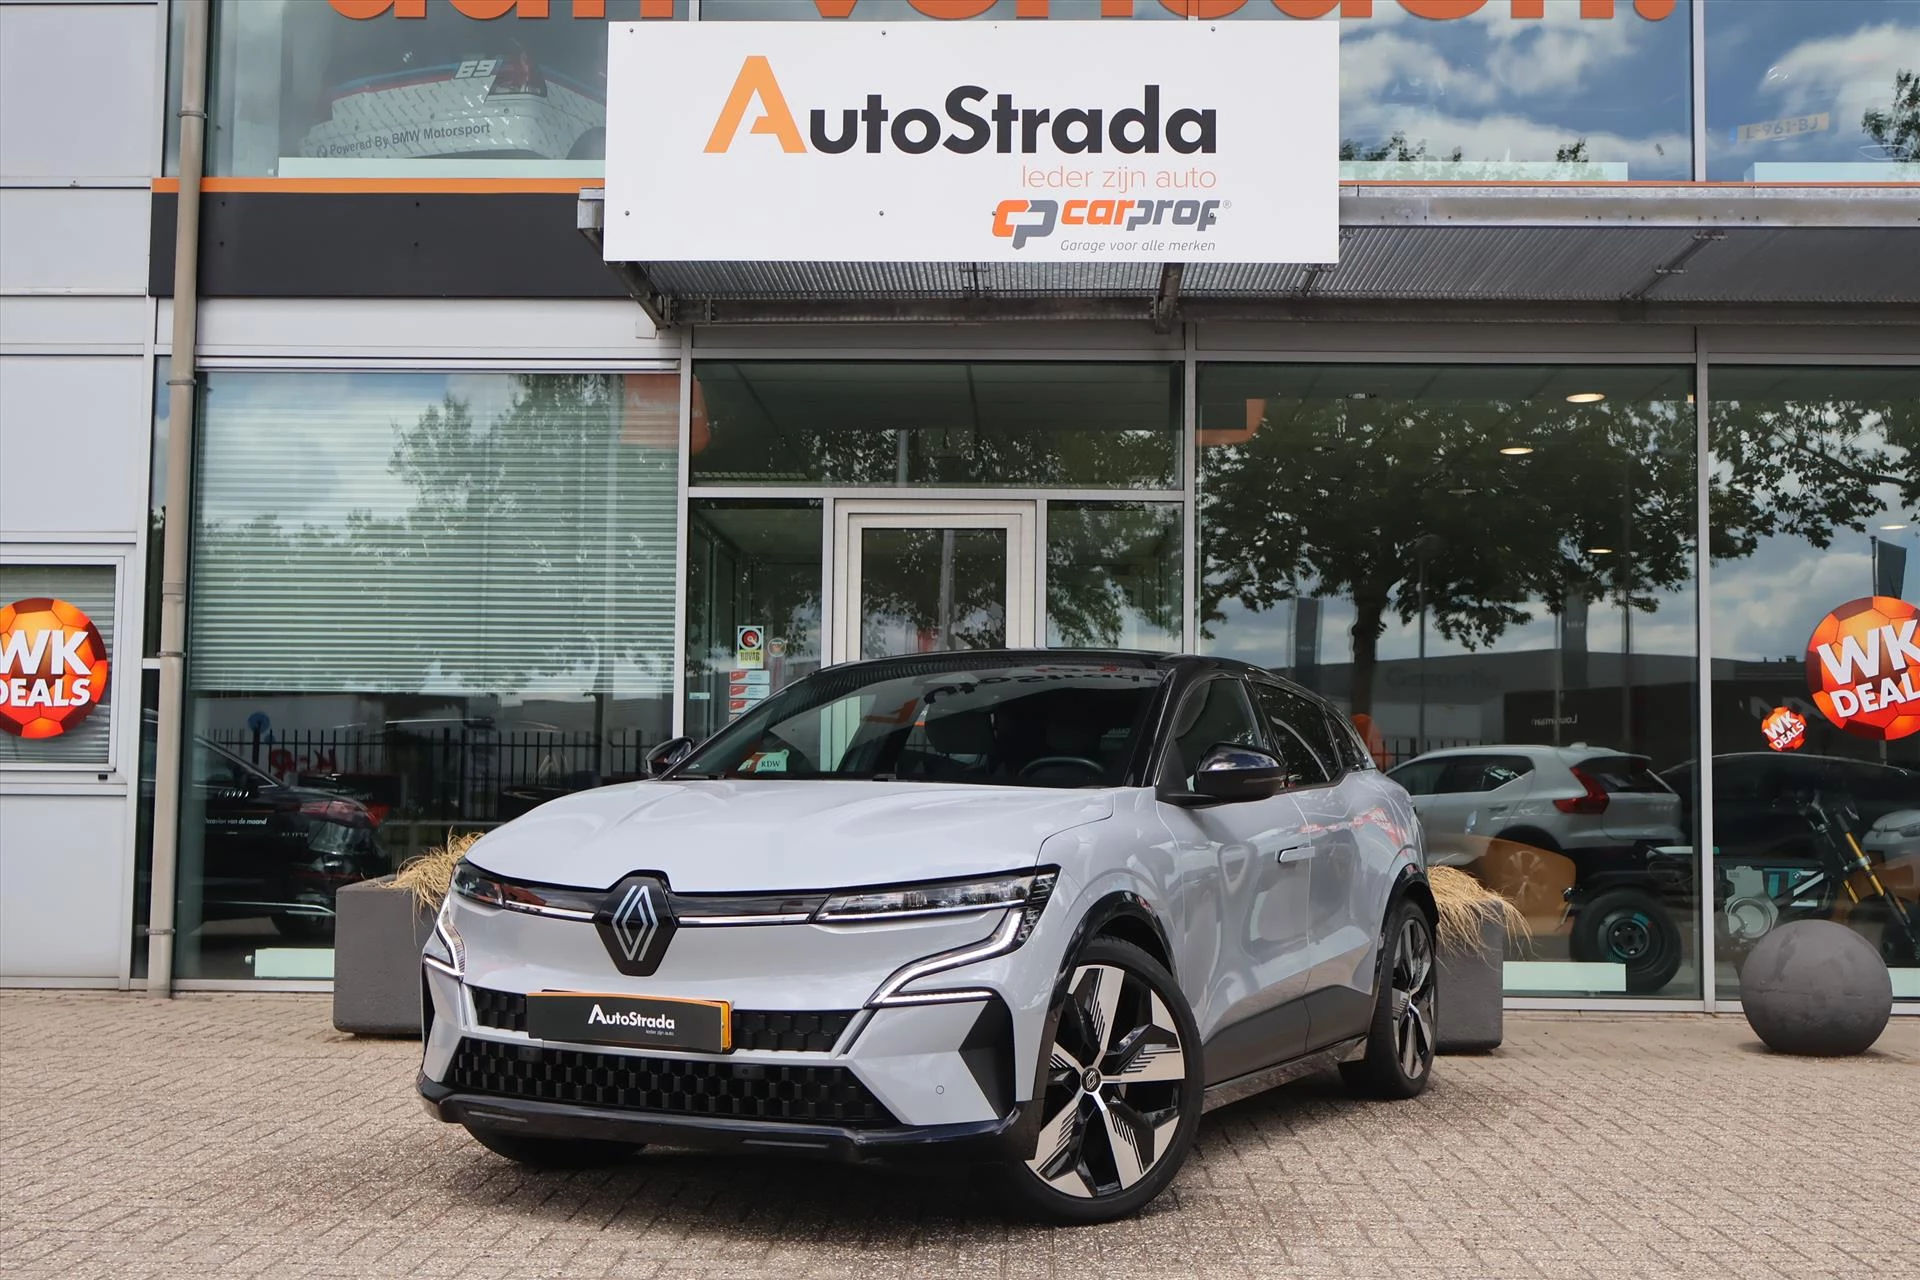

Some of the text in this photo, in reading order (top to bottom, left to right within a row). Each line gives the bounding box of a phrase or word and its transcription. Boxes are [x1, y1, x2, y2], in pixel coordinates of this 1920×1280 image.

[455, 60, 497, 79] 69
[704, 56, 1217, 155] AutoStrada
[330, 122, 491, 156] Powered By BMW Motorsport
[1021, 165, 1217, 193] Ieder zijn auto
[1061, 200, 1221, 231] carprof
[1060, 240, 1216, 254] Garage voor alle merken
[1816, 619, 1920, 686] WK
[1829, 672, 1920, 719] DEAL
[1764, 710, 1799, 739] WK
[1773, 722, 1805, 749] DEALS
[588, 1004, 675, 1029] AutoStrada
